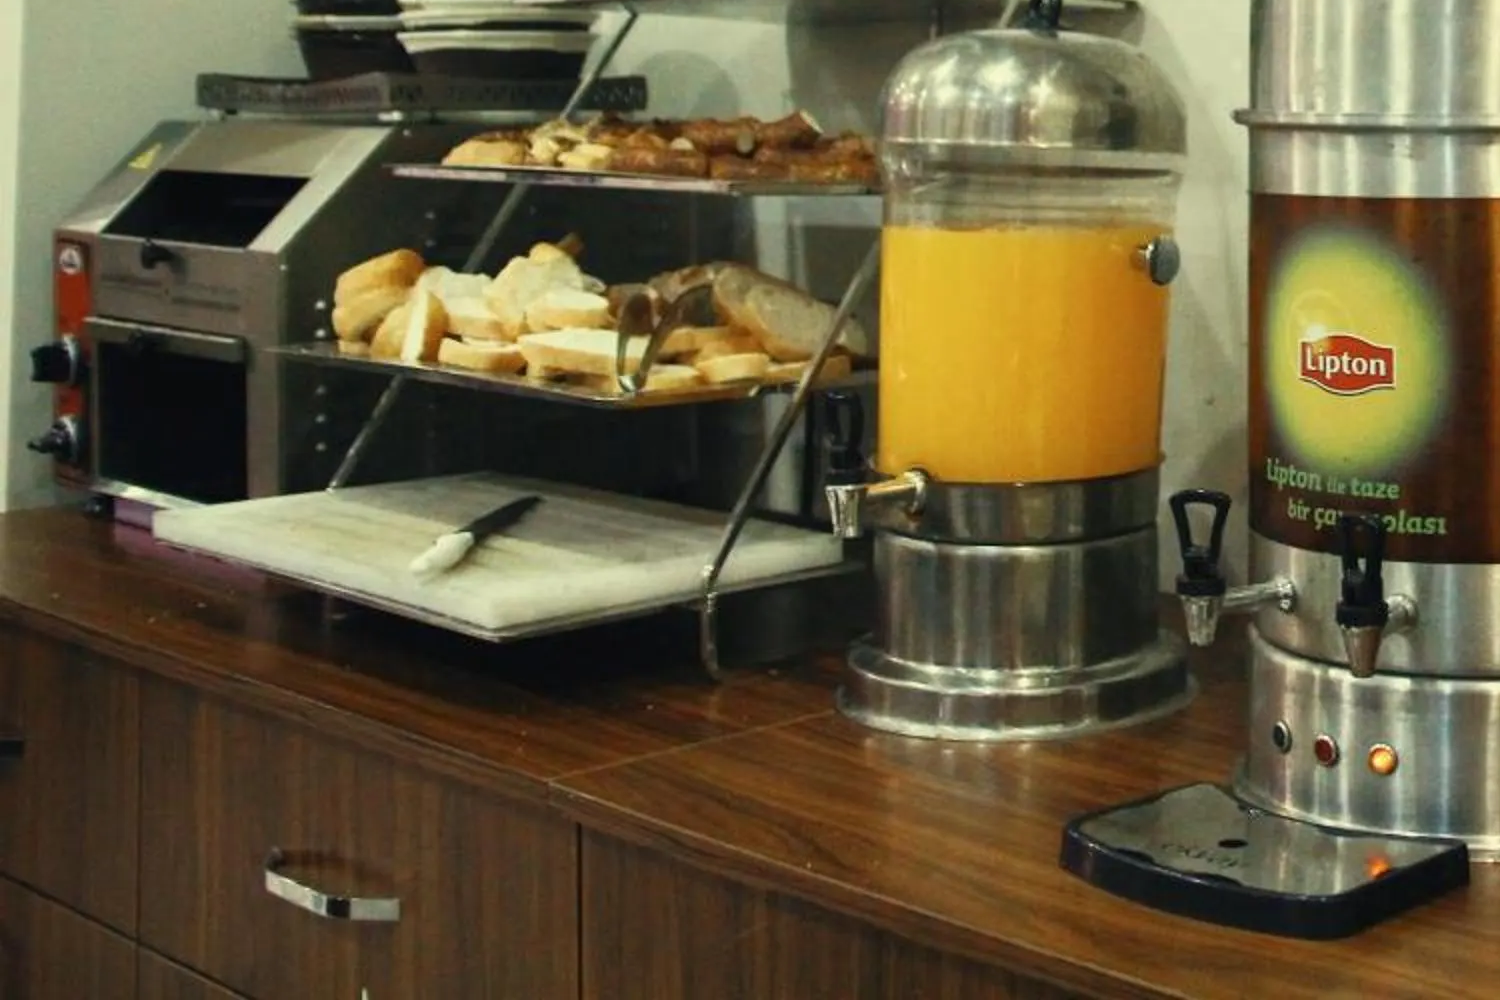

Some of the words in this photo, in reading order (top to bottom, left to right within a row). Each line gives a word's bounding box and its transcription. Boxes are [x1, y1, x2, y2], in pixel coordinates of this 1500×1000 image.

[1306, 345, 1387, 380] Lipton
[1265, 457, 1323, 491] Lipton
[1326, 475, 1346, 495] ile
[1350, 476, 1400, 500] taze
[1287, 497, 1311, 521] bir
[1313, 506, 1343, 531] ça
